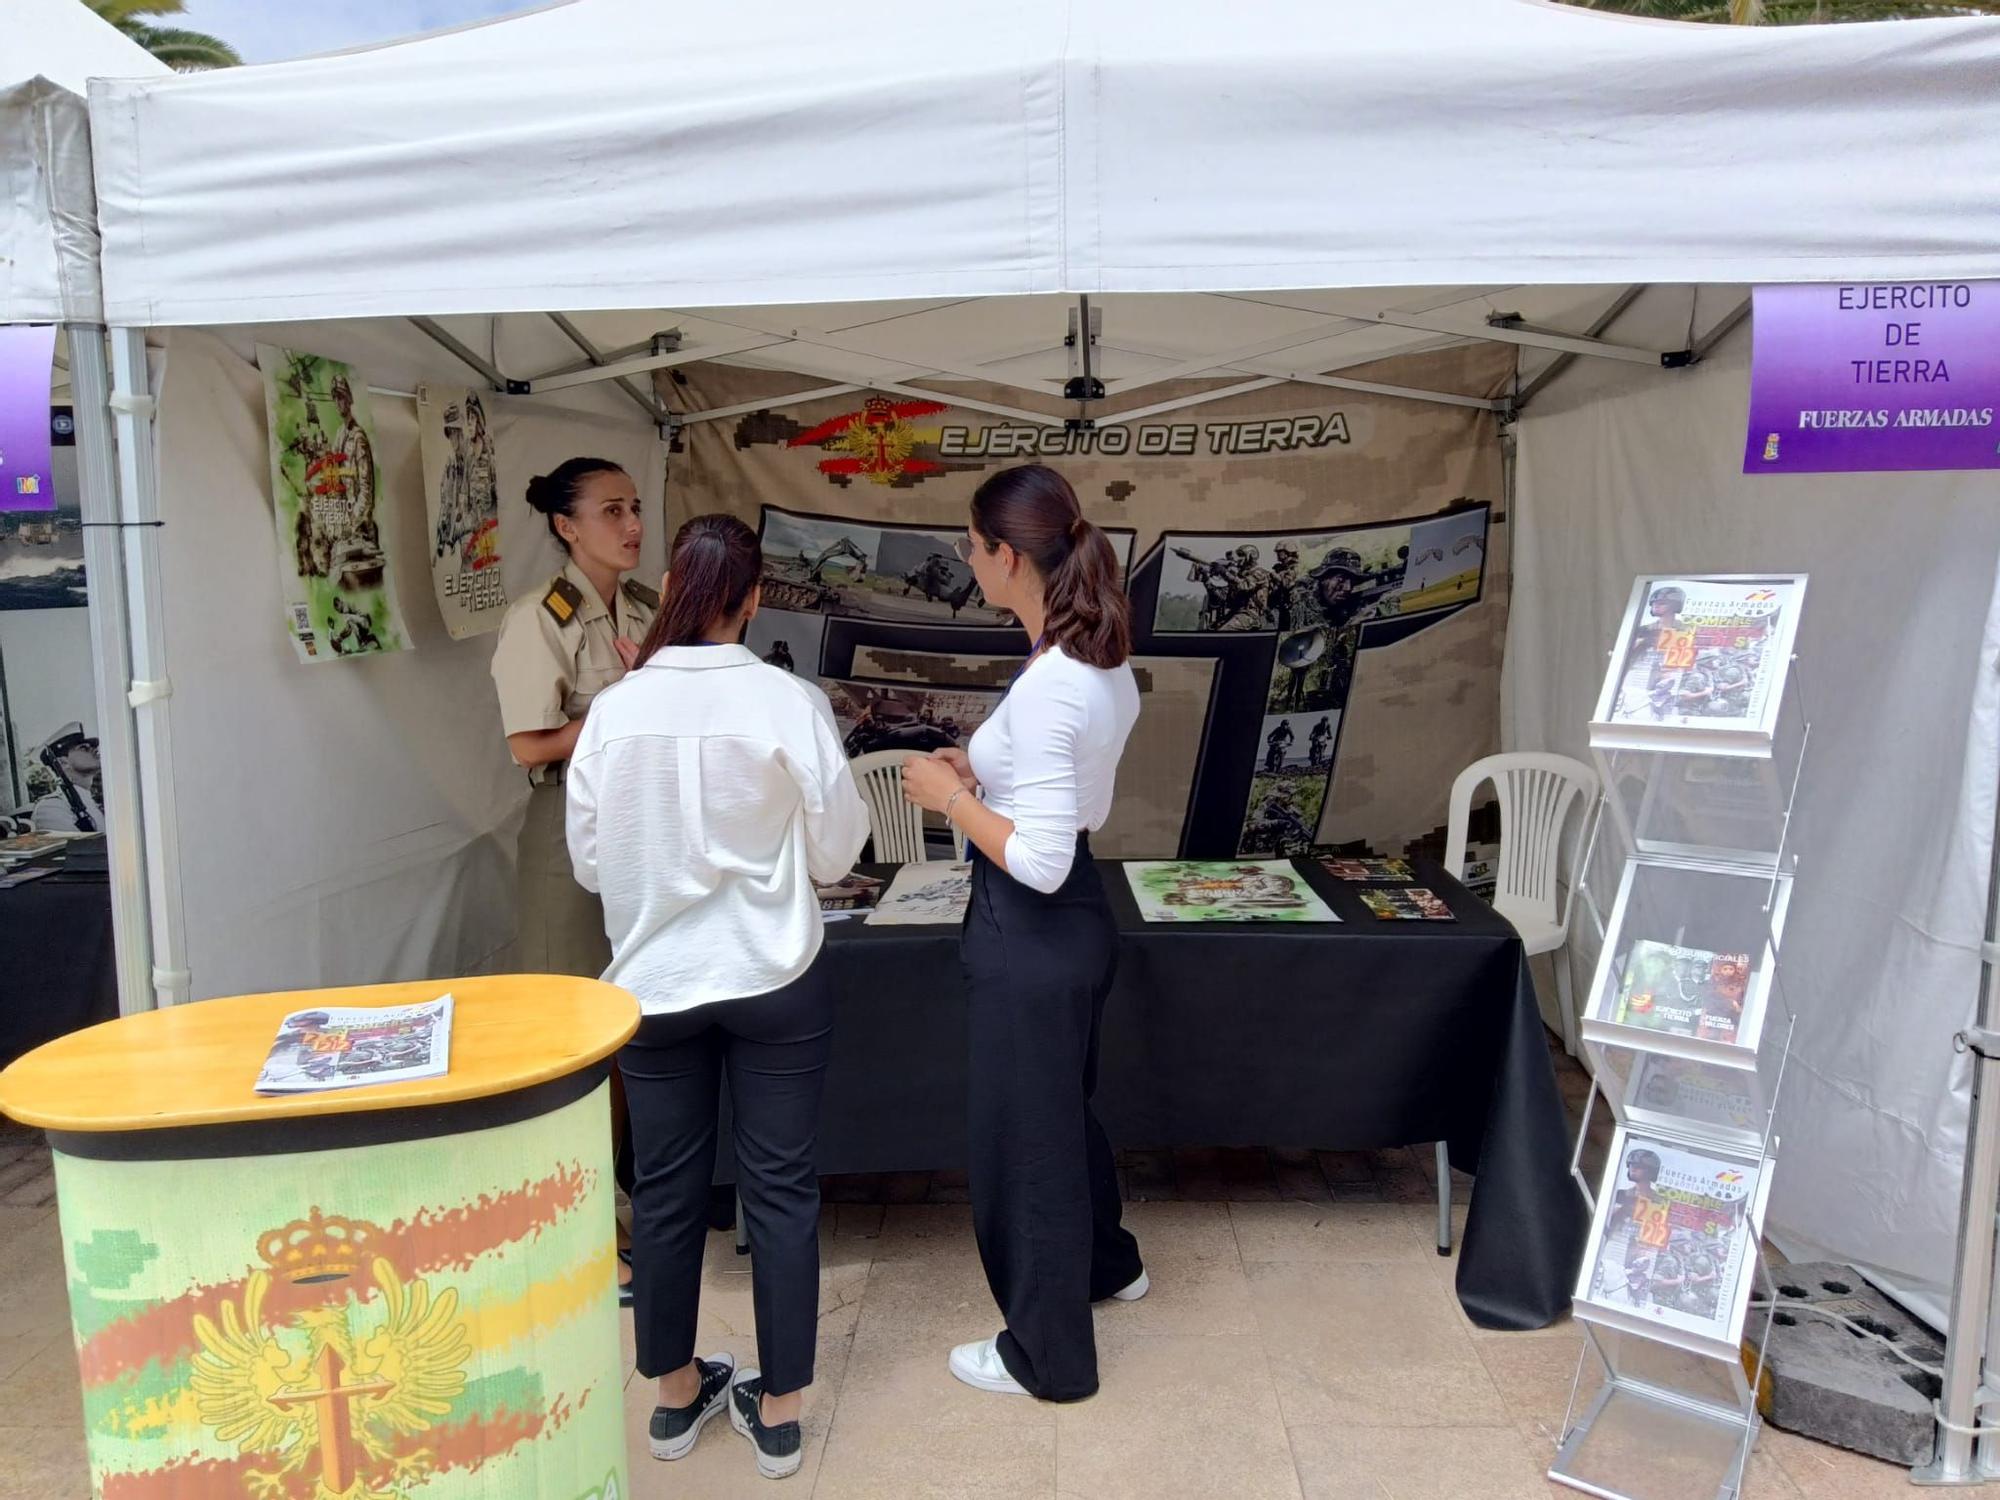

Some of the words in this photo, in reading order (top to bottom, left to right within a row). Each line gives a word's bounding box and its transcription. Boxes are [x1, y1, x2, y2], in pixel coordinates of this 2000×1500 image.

[1839, 285, 1971, 309] EJERCITO
[1885, 323, 1921, 346] DE
[1851, 359, 1949, 383] TIERRA
[1799, 409, 1889, 428] FUERZAS
[1894, 407, 1993, 427] ARMADAS
[939, 422, 1130, 456] EJÉRCITO
[1137, 424, 1198, 455] DE
[1205, 412, 1350, 454] TIERRA
[1660, 1165, 1697, 1184] Fuerzas
[1701, 1175, 1743, 1195] Armadas
